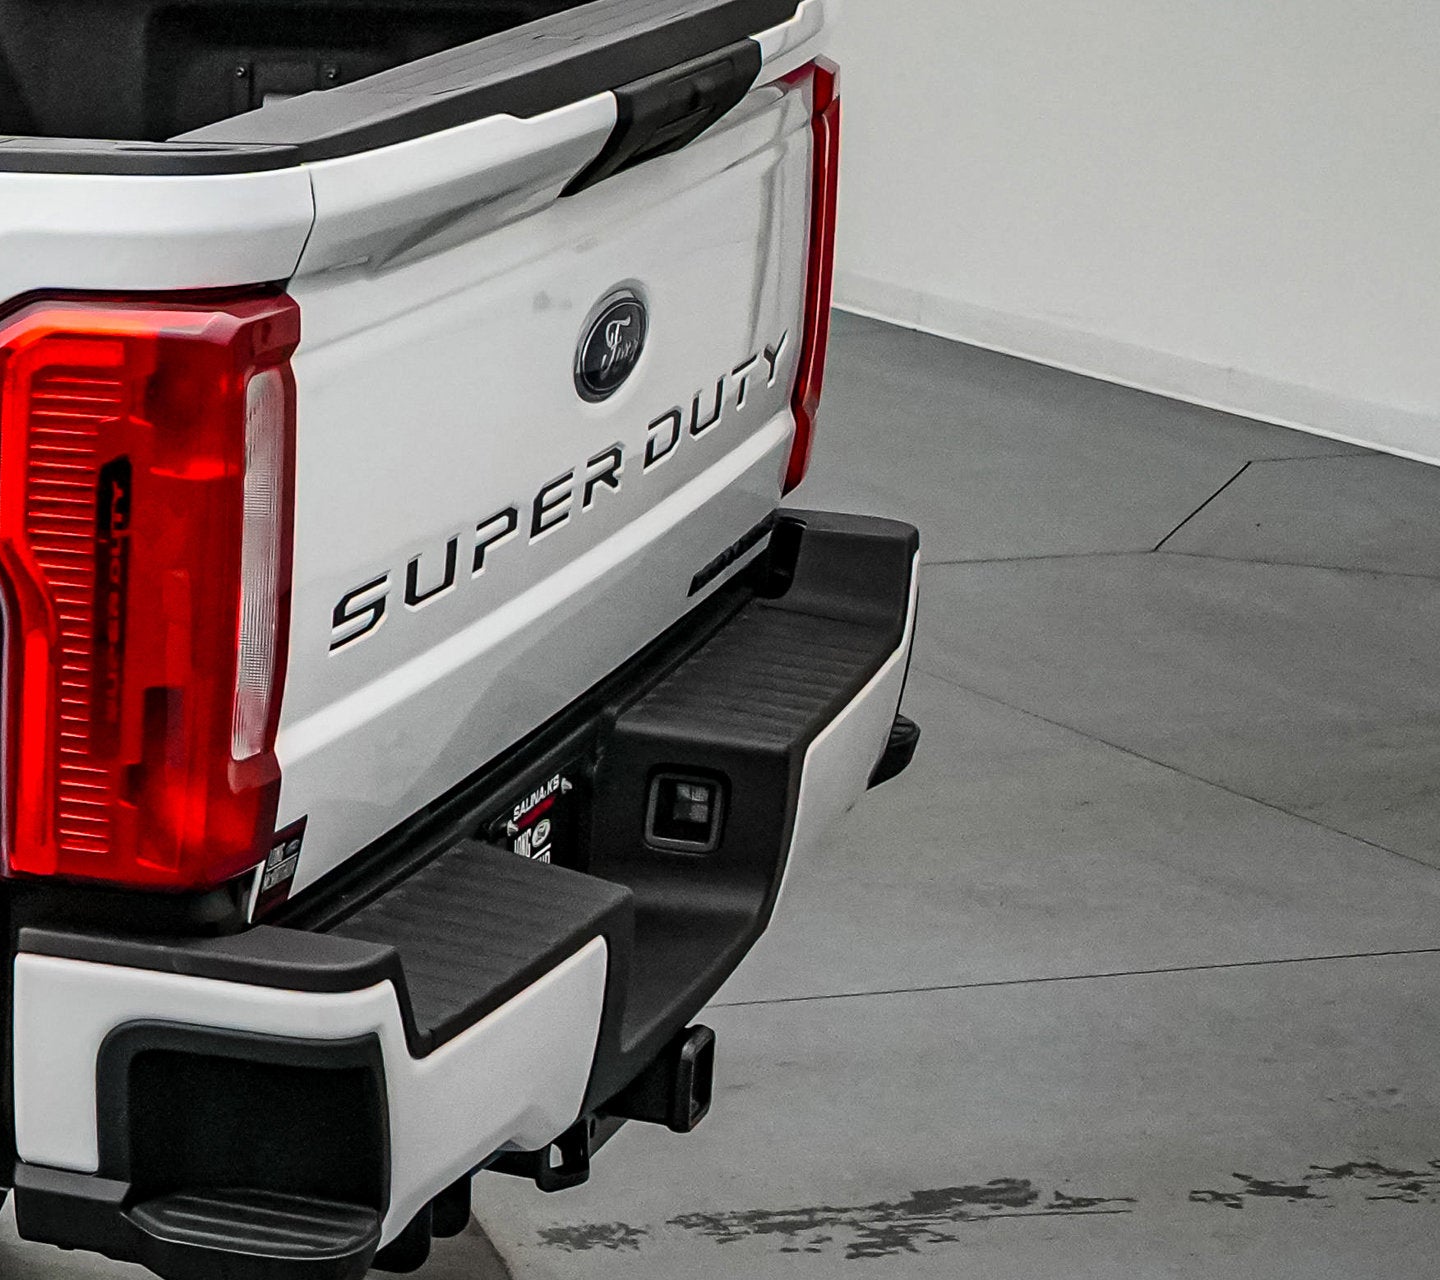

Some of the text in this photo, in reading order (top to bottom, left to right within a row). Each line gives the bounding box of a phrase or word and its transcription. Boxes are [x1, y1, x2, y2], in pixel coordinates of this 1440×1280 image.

[328, 442, 625, 656] SUPER
[643, 330, 787, 475] DUTY
[547, 773, 560, 796] KS
